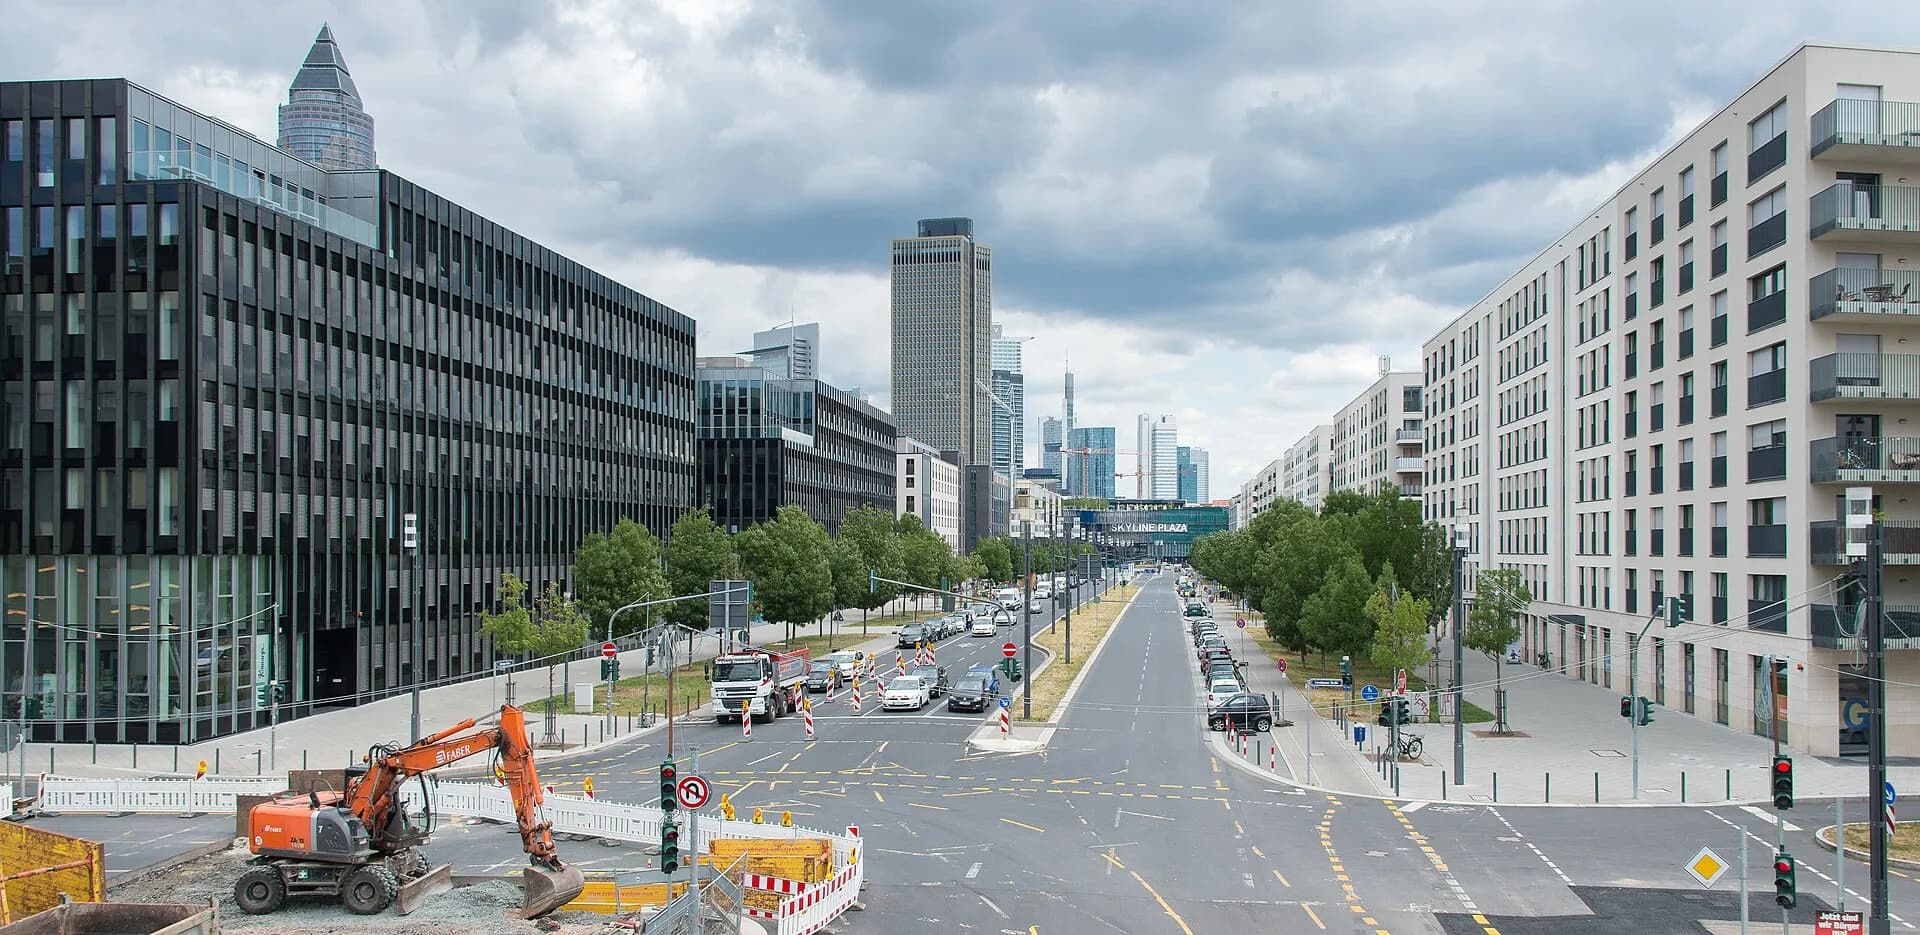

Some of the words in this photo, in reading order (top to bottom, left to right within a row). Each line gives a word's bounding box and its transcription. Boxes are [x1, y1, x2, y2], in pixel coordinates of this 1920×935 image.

[1111, 523, 1155, 532] SKYLINE
[1158, 523, 1188, 532] PLAZA
[446, 744, 471, 761] FABER
[317, 825, 323, 833] 7
[1820, 912, 1840, 921] Jetzt
[1818, 920, 1832, 928] wir
[1833, 921, 1860, 931] Bürger
